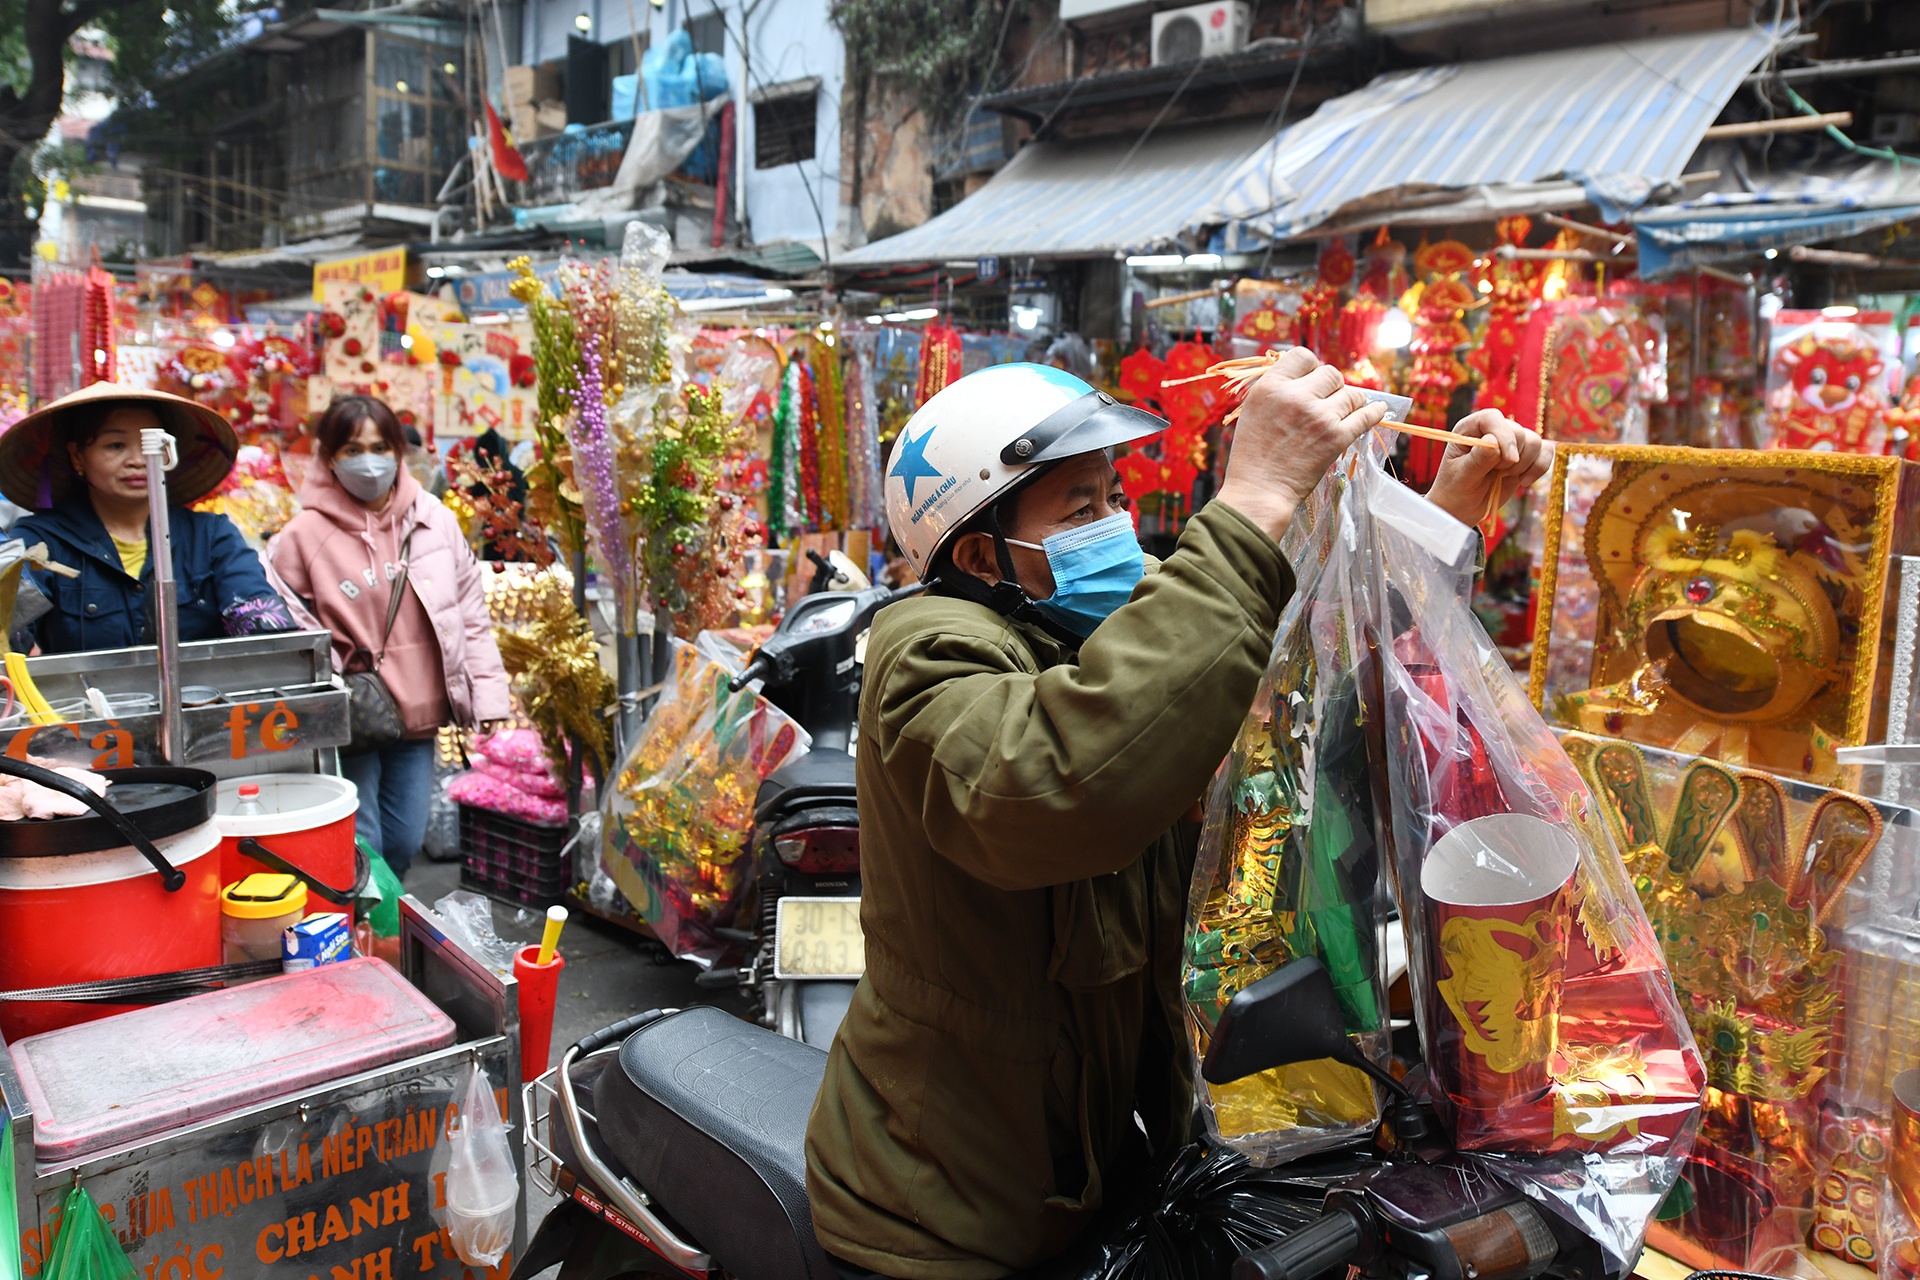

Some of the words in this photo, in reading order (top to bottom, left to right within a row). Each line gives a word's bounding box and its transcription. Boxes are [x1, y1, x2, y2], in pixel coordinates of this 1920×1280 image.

[911, 508, 924, 525] NGÂN
[921, 494, 938, 511] HÀNG
[935, 488, 942, 499] Á
[940, 476, 957, 493] CHÂU
[223, 699, 299, 760] fê
[182, 1152, 275, 1224] THẠCH
[279, 1132, 313, 1192] LÁ
[322, 1115, 373, 1179] NẾP
[374, 1104, 437, 1163] TRÂN
[255, 1182, 411, 1265] CHANH
[615, 1217, 651, 1244] STARTER
